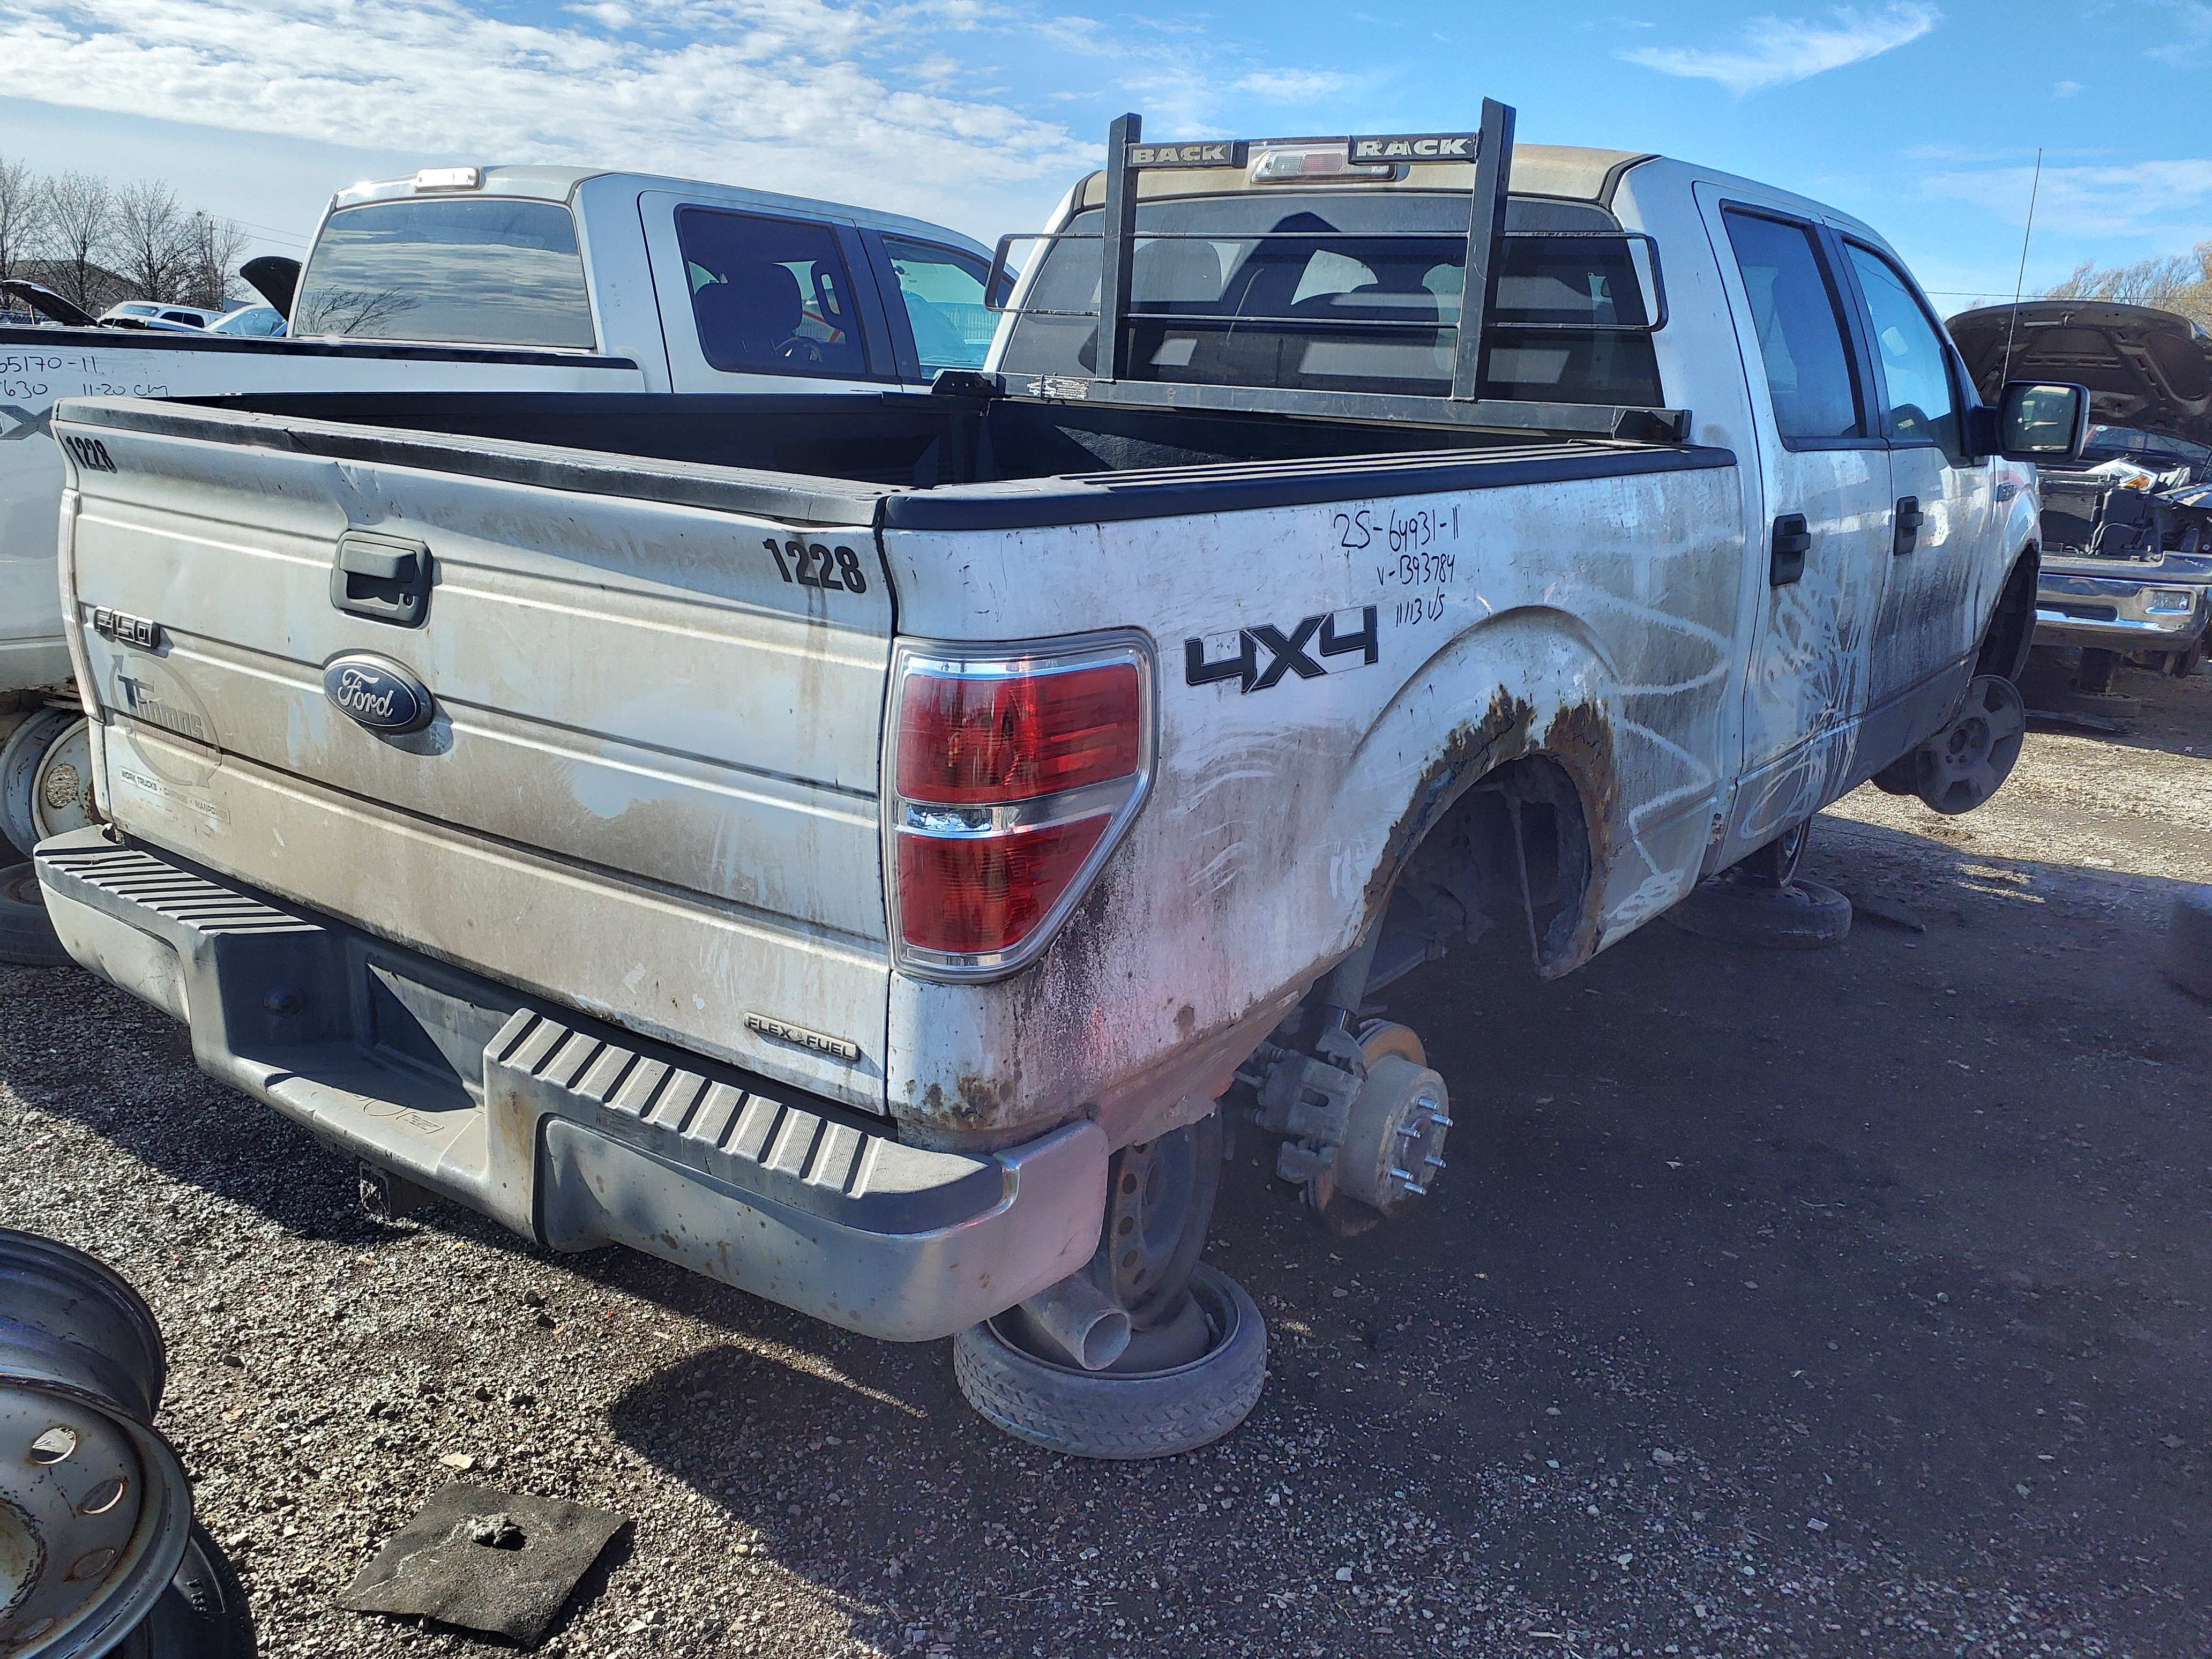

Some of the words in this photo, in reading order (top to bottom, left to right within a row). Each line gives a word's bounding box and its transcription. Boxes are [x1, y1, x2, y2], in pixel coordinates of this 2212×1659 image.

[1132, 145, 1227, 163] BACK
[1356, 138, 1469, 156] RACK
[83, 383, 126, 397] 11-20
[66, 436, 117, 474] 1228
[762, 538, 867, 594] 1228
[338, 668, 394, 718] Ford
[121, 769, 136, 782] WORK
[137, 776, 158, 791] TRUCKS
[748, 1016, 794, 1040] FLEX
[806, 1034, 855, 1058] FUEL
